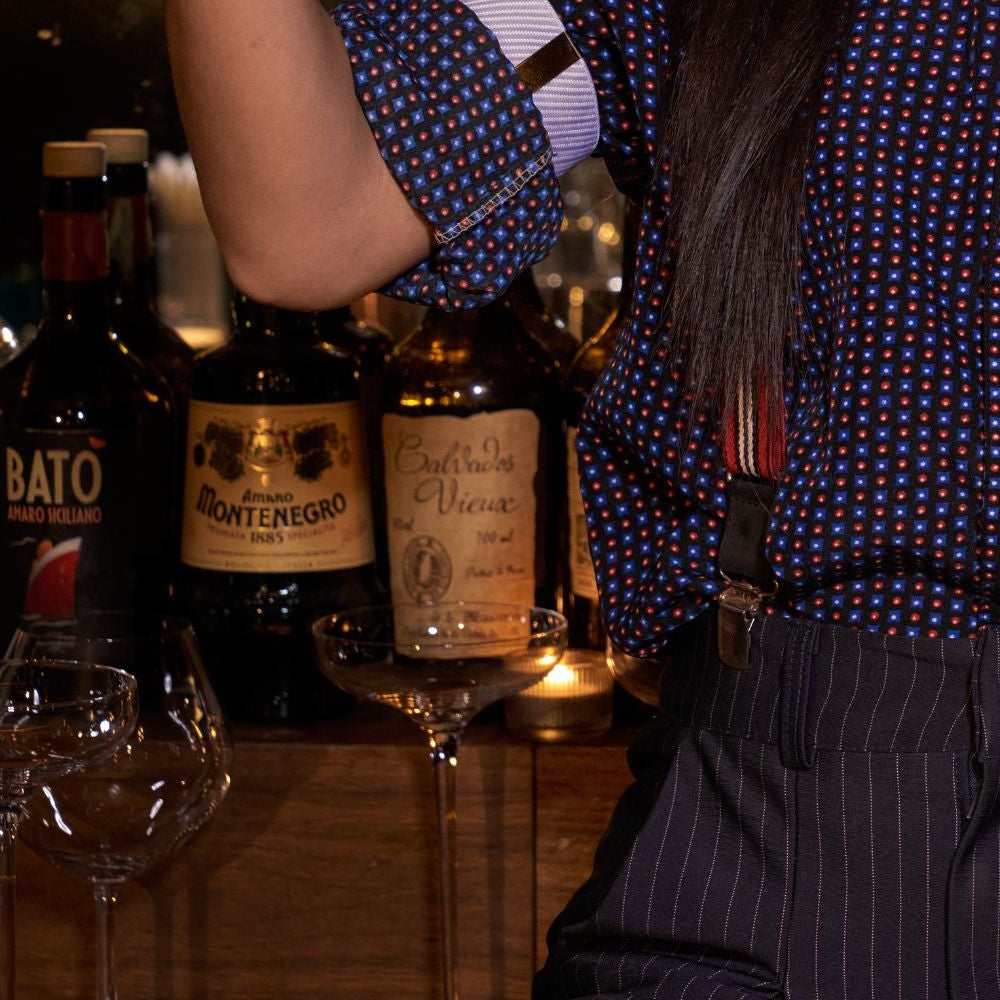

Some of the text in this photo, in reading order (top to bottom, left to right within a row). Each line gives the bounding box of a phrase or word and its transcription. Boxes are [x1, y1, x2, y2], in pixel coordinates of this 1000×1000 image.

[396, 431, 515, 474] Calvados
[7, 503, 103, 526] AMARO SICILIANO
[196, 483, 346, 528] MONTENEGRO
[414, 477, 519, 516] Vieux
[250, 531, 284, 545] 1885
